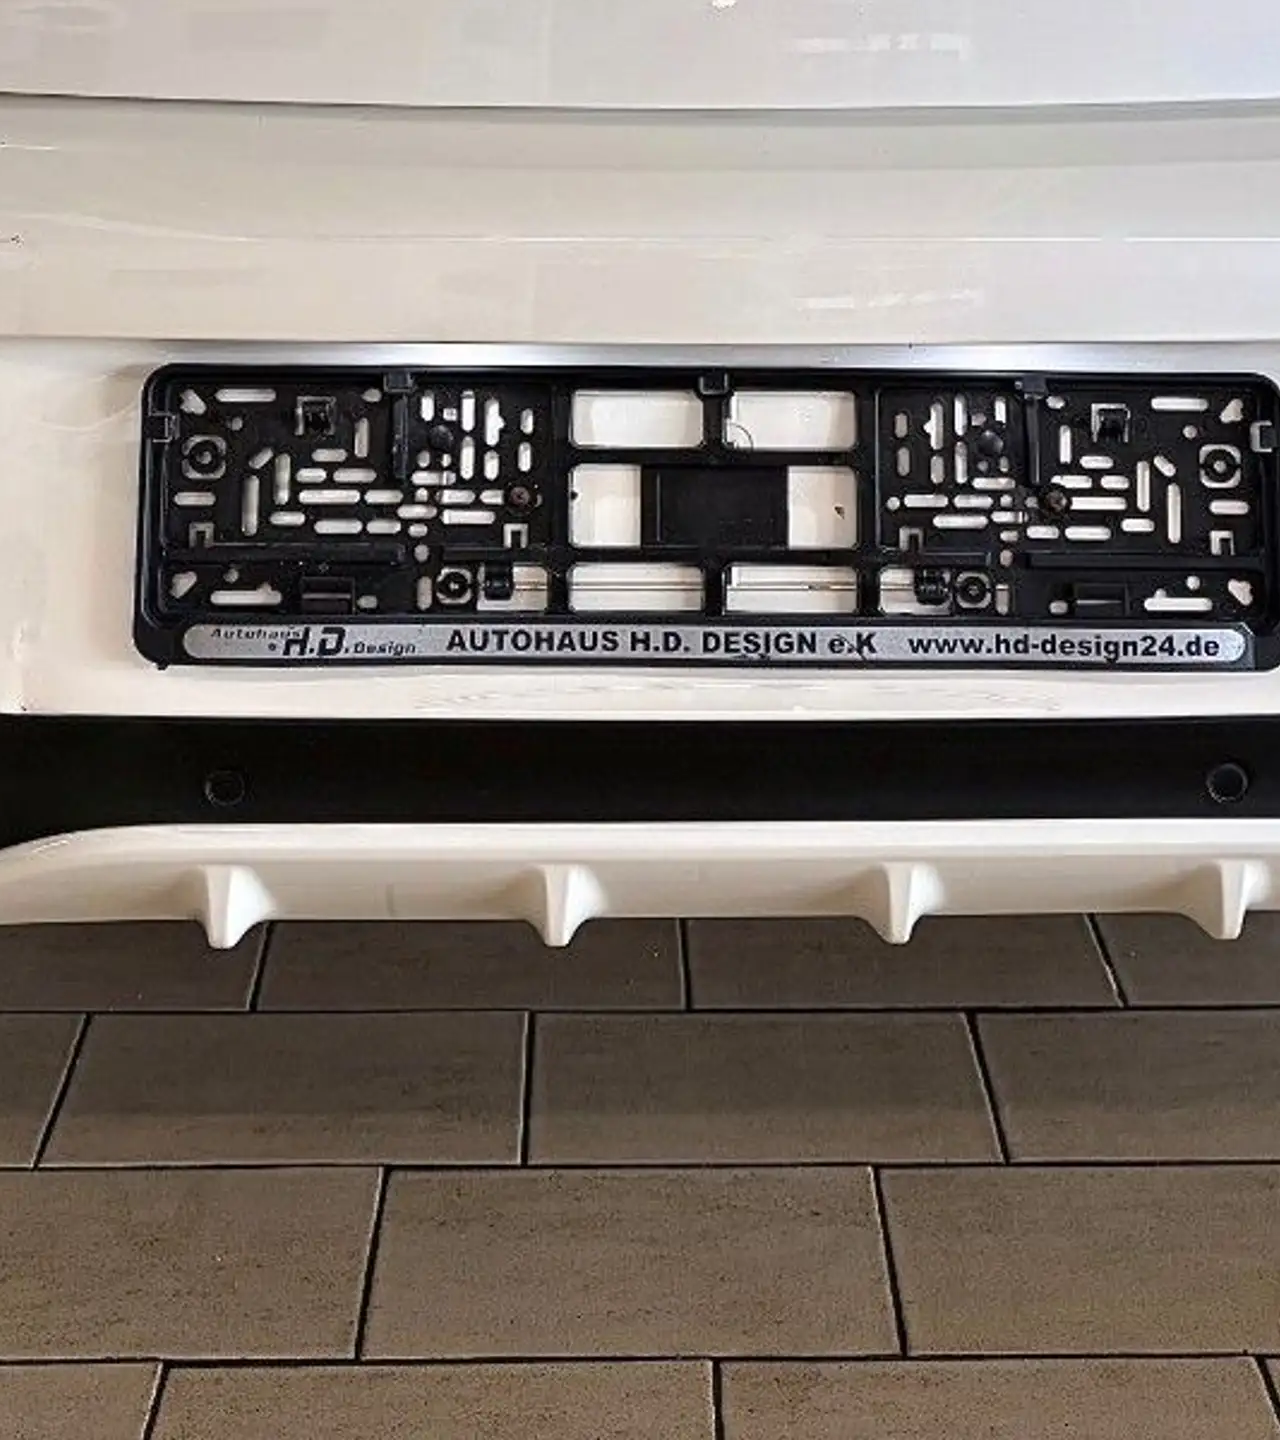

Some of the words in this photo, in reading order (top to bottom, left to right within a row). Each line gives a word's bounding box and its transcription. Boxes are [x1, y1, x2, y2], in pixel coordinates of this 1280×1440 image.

[210, 626, 301, 640] Autohaus
[352, 640, 417, 657] Design
[445, 629, 620, 652] AUTOHAUS
[629, 630, 690, 653] H.D.
[701, 631, 818, 654] DESIGN
[907, 633, 1220, 661] www.hd-design24.de
